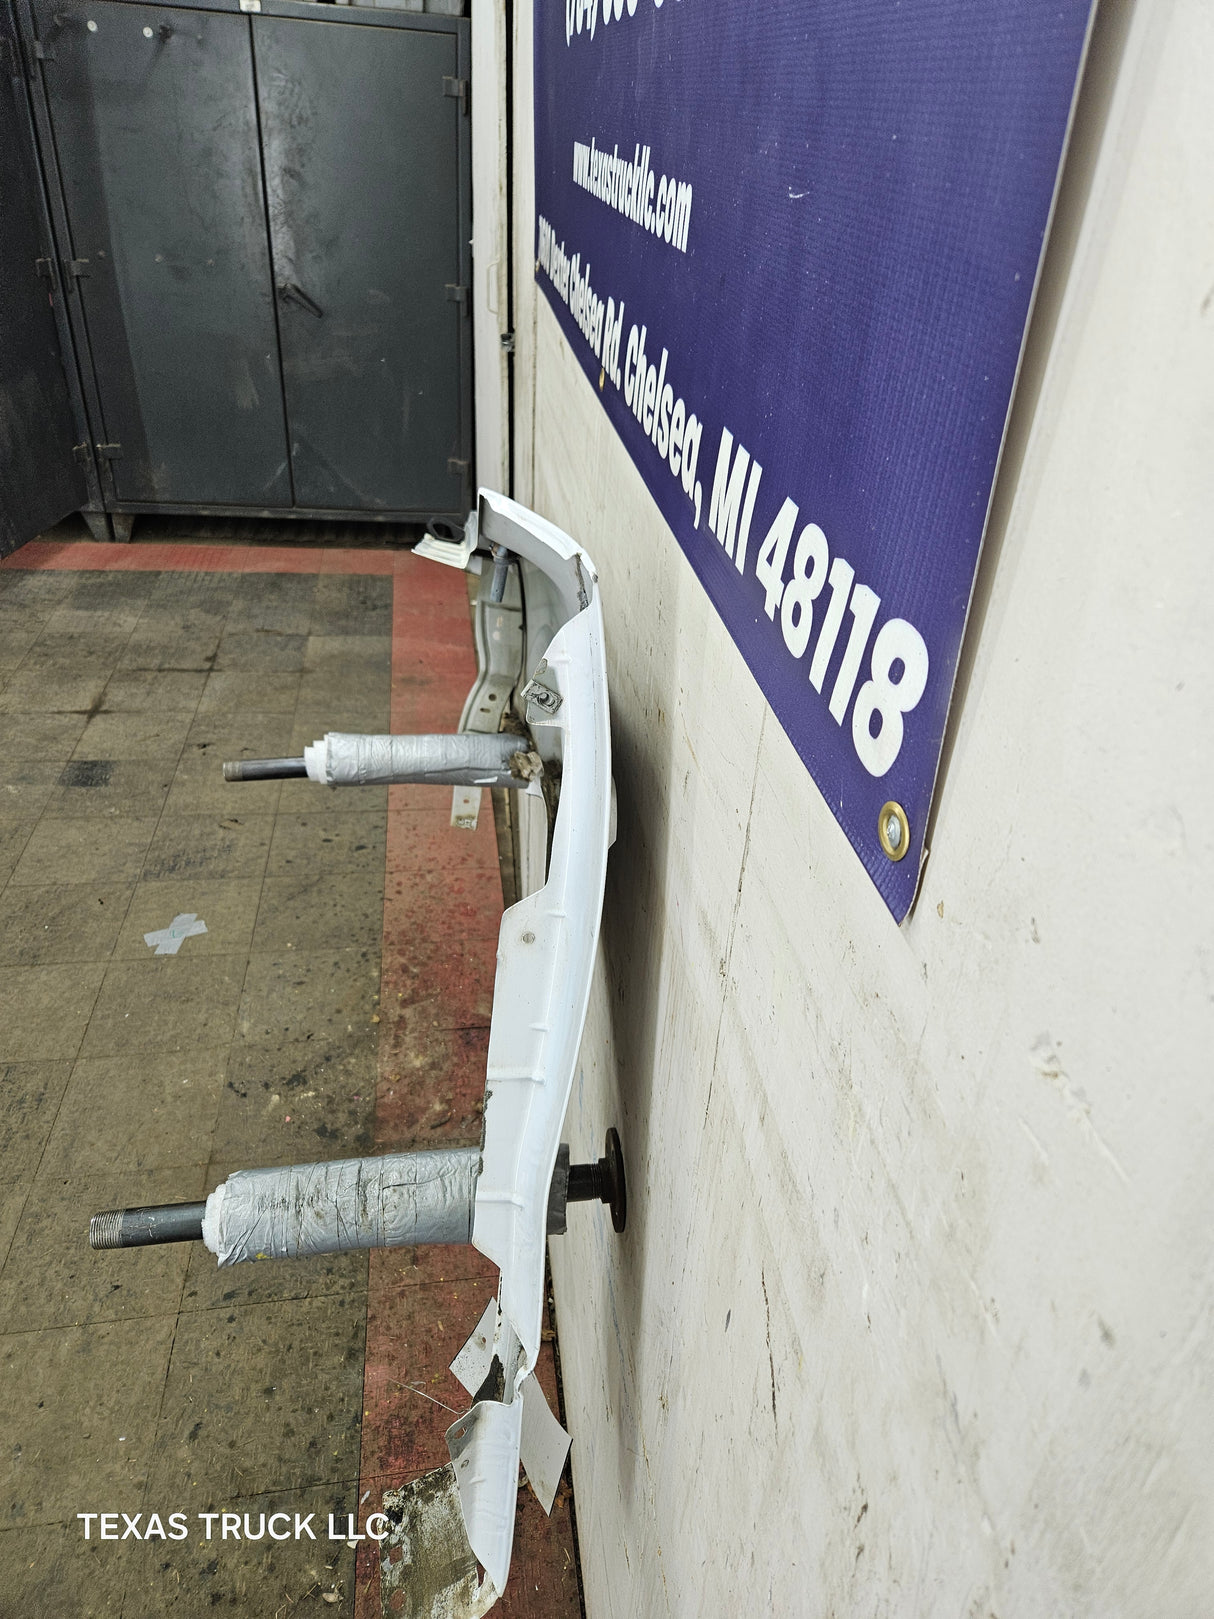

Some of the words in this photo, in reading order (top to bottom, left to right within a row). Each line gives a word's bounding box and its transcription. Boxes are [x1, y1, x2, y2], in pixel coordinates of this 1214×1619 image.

[569, 253, 605, 359] Chelsea
[602, 296, 625, 391] Rd.
[624, 324, 702, 530] Chelsea,
[708, 426, 763, 576] MI
[756, 496, 929, 778] 48118
